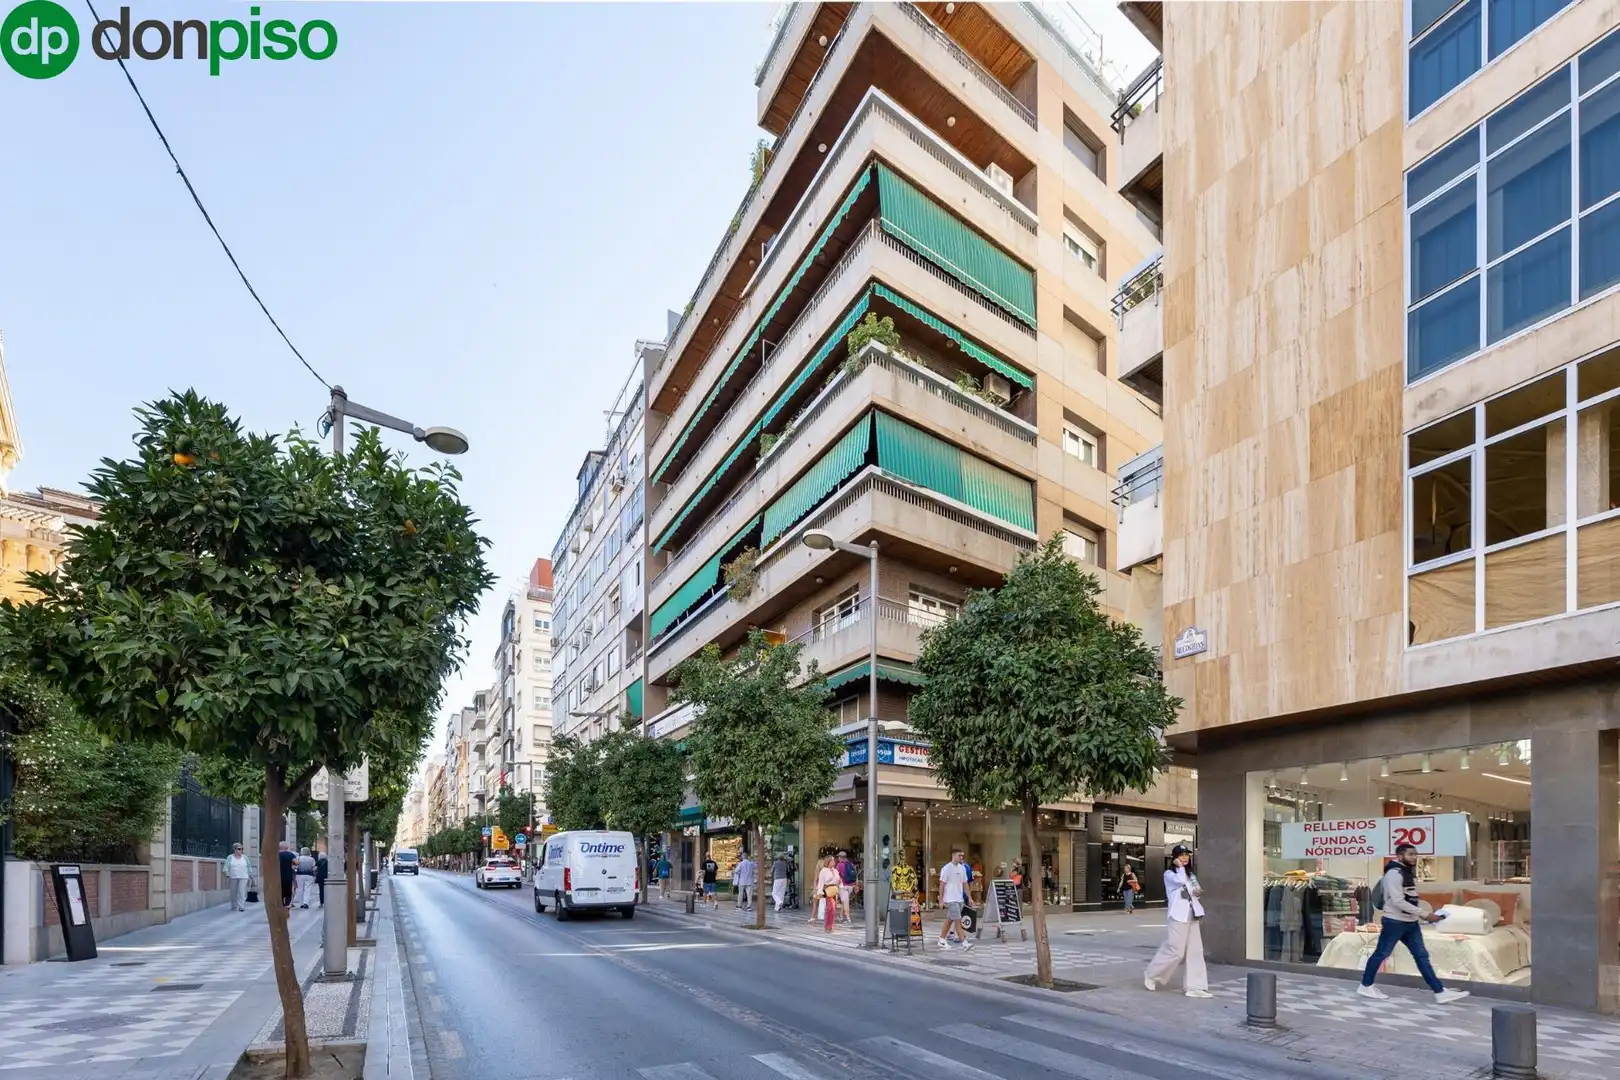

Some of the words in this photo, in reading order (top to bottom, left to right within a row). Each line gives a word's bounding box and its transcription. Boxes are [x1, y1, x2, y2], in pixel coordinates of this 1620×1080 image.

[899, 745, 928, 756] GESTIO
[1304, 819, 1377, 832] RELLENOS
[1312, 834, 1367, 846] FUNDAS
[580, 842, 625, 854] Ontime
[1305, 845, 1375, 856] NÓRDICAS
